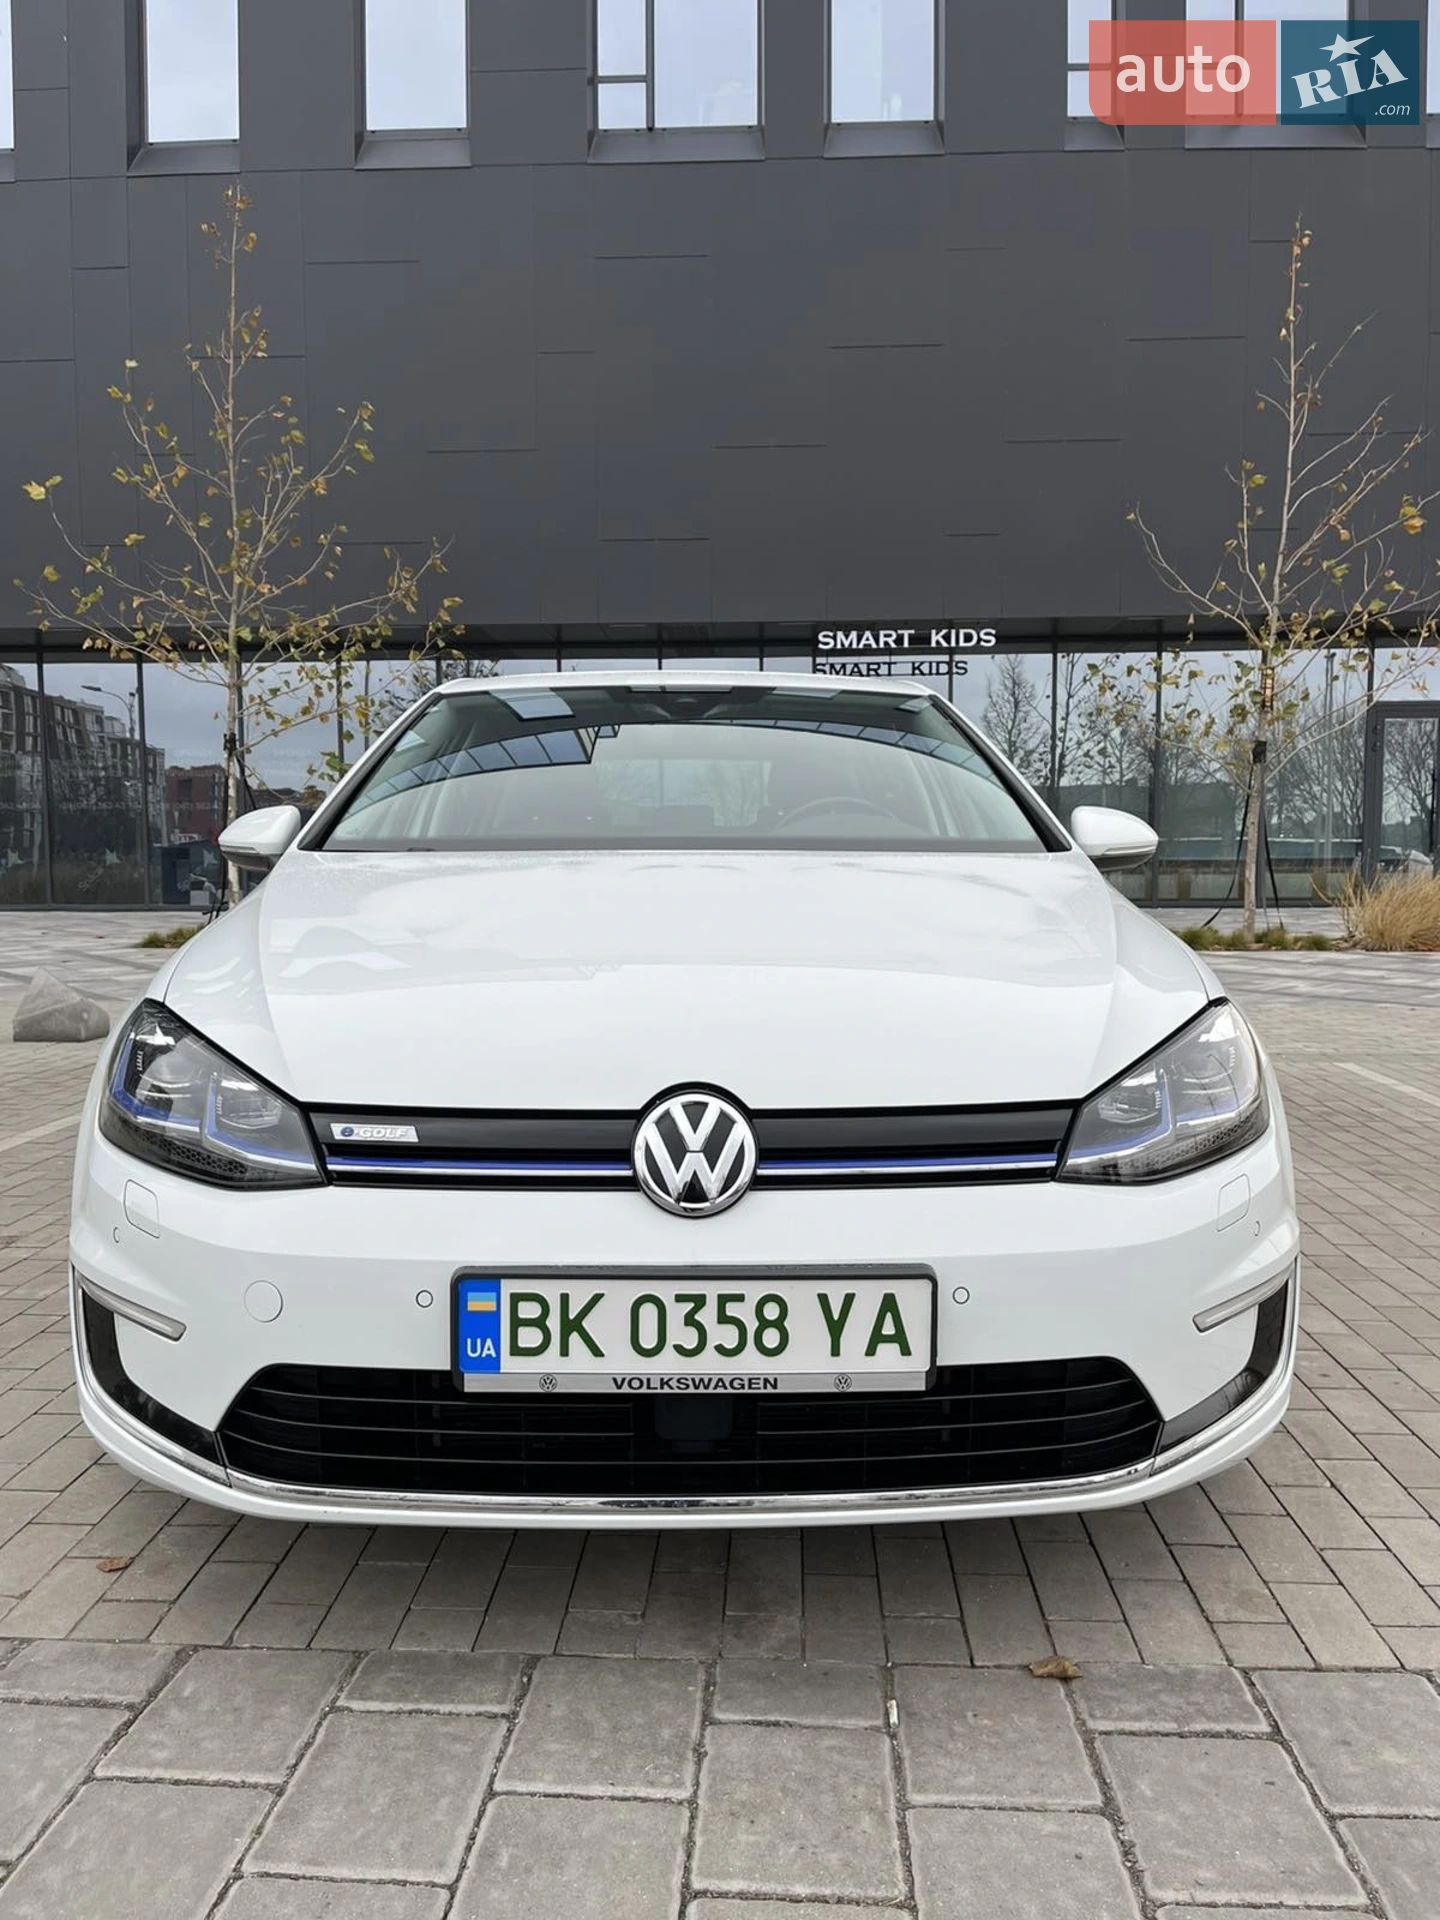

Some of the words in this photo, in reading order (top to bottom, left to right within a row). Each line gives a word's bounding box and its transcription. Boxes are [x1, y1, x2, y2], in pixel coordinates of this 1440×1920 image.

[818, 630, 915, 649] SMART
[930, 628, 996, 647] KIDS
[814, 662, 898, 677] SMART
[911, 660, 968, 676] KIDS
[509, 1292, 605, 1357] BK
[629, 1292, 790, 1358] 0358
[817, 1292, 912, 1357] YA
[466, 1338, 497, 1358] UA
[612, 1376, 779, 1391] VOLKSWAGEN
